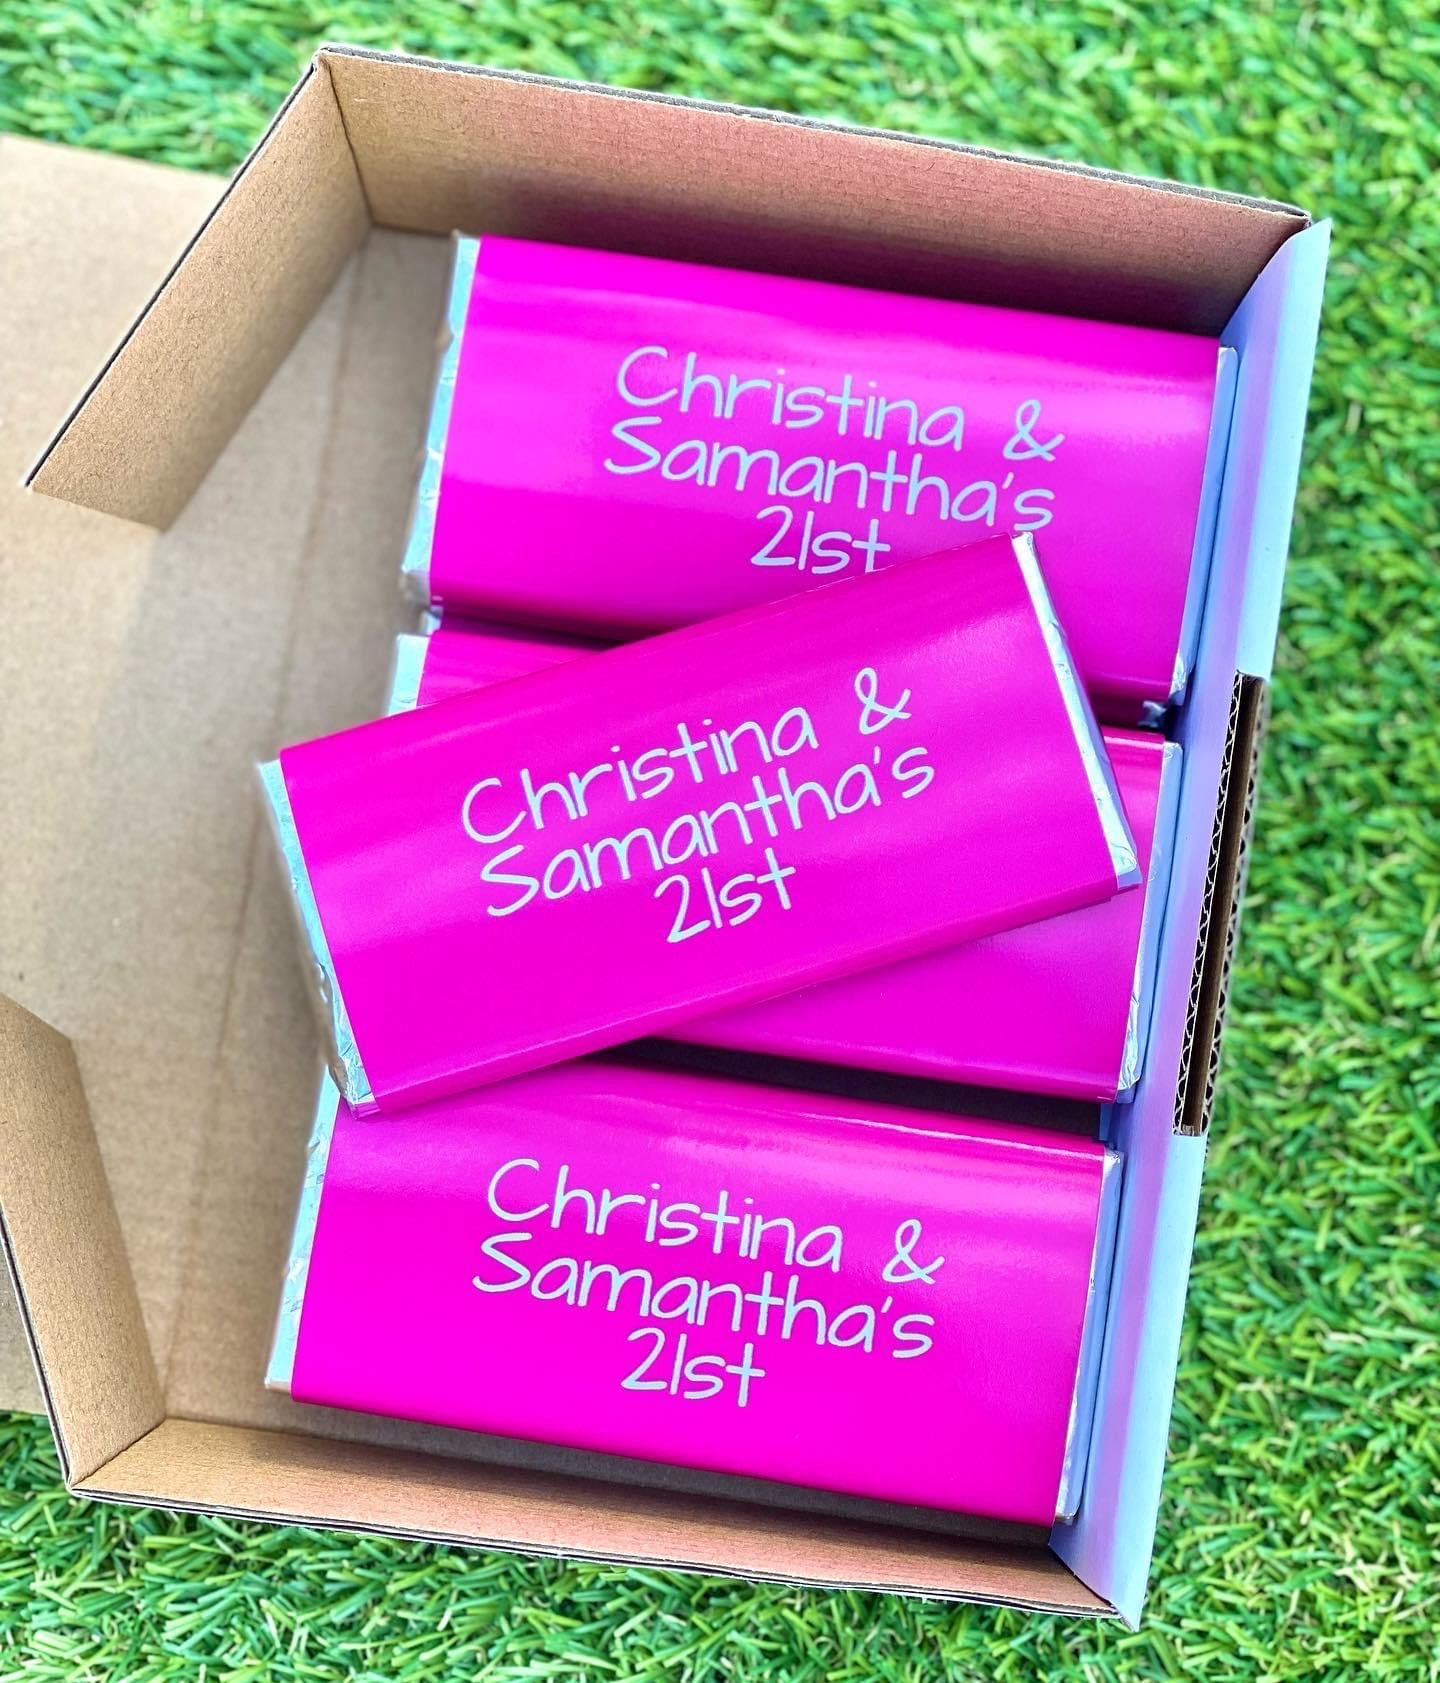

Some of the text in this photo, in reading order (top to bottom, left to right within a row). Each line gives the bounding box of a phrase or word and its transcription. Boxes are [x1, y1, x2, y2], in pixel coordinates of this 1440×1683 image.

[615, 345, 1065, 462] Christina &
[603, 415, 1056, 531] Samantha's
[750, 504, 892, 574] 21st
[460, 666, 913, 844] Christina &
[479, 746, 935, 917] Samantha's
[654, 847, 796, 944] 21st
[487, 1158, 946, 1285] Christina &
[472, 1232, 935, 1359] Samantha's
[620, 1327, 766, 1408] 21st
